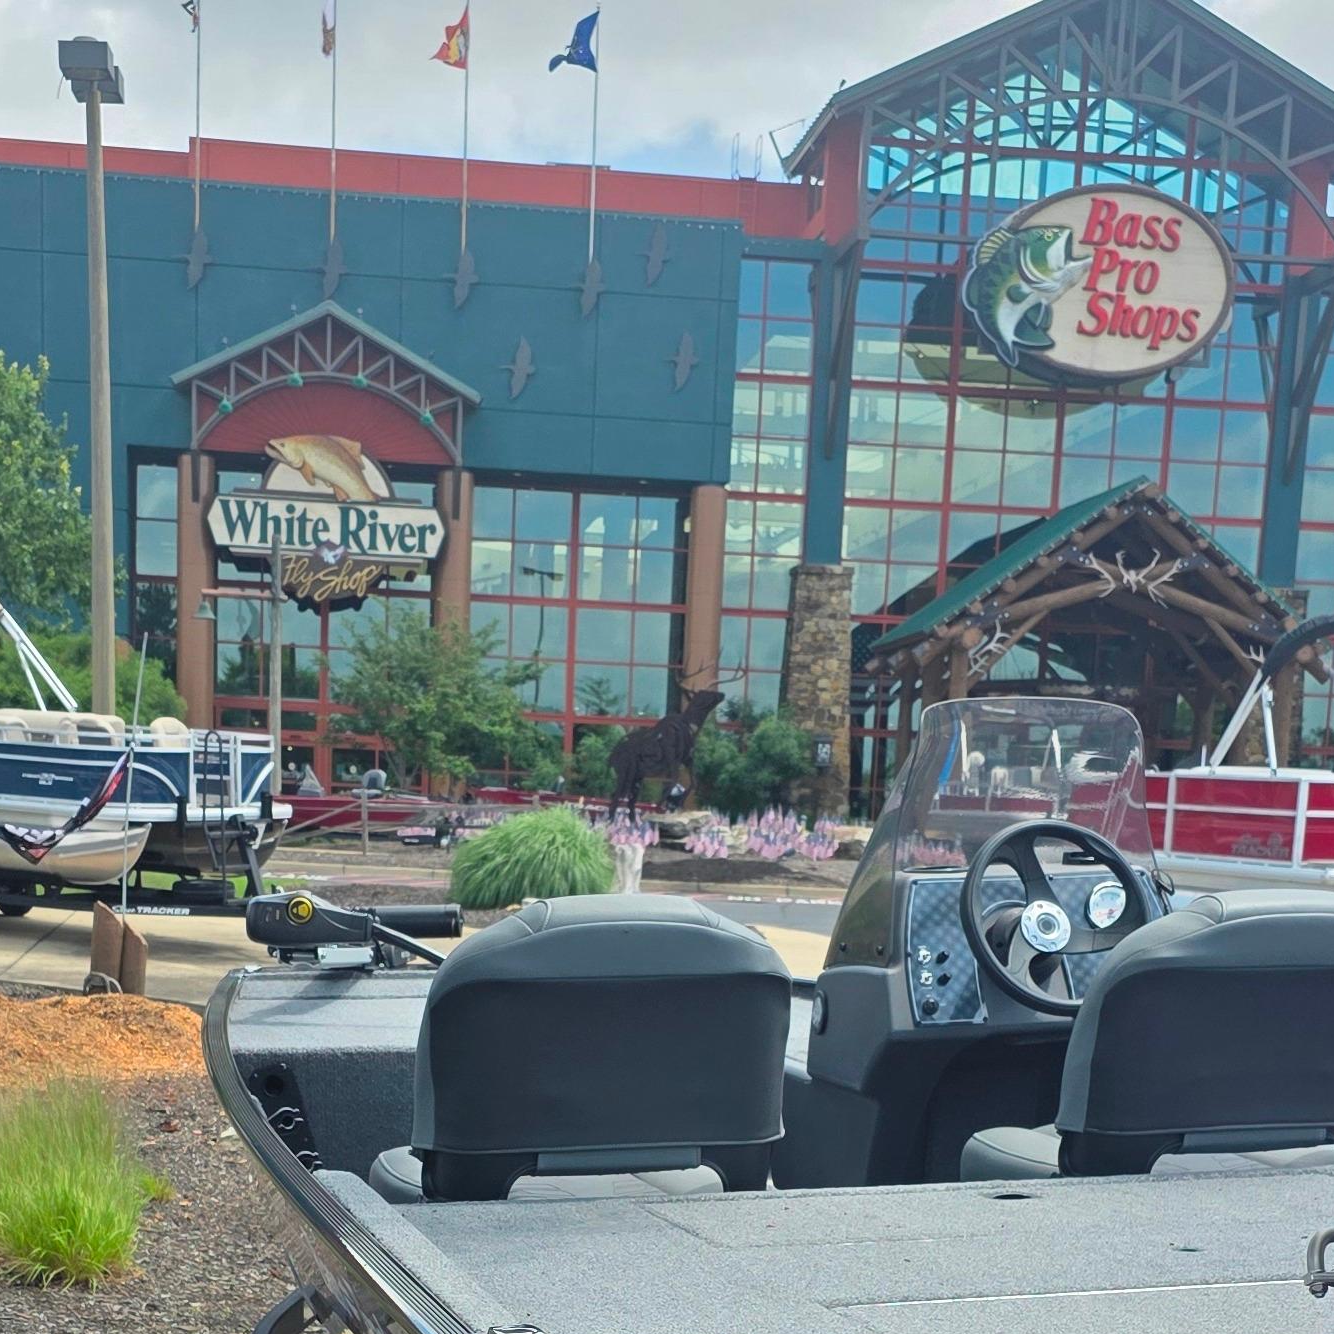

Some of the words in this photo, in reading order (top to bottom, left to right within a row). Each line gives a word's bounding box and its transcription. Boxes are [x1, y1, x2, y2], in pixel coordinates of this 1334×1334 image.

[1078, 196, 1183, 253] Bass
[1081, 247, 1161, 295] Pro
[1075, 291, 1201, 350] Shops
[218, 499, 331, 549] White
[337, 505, 438, 556] River
[280, 553, 317, 598] Fly
[313, 558, 383, 601] Shop
[136, 905, 191, 916] TRACKER
